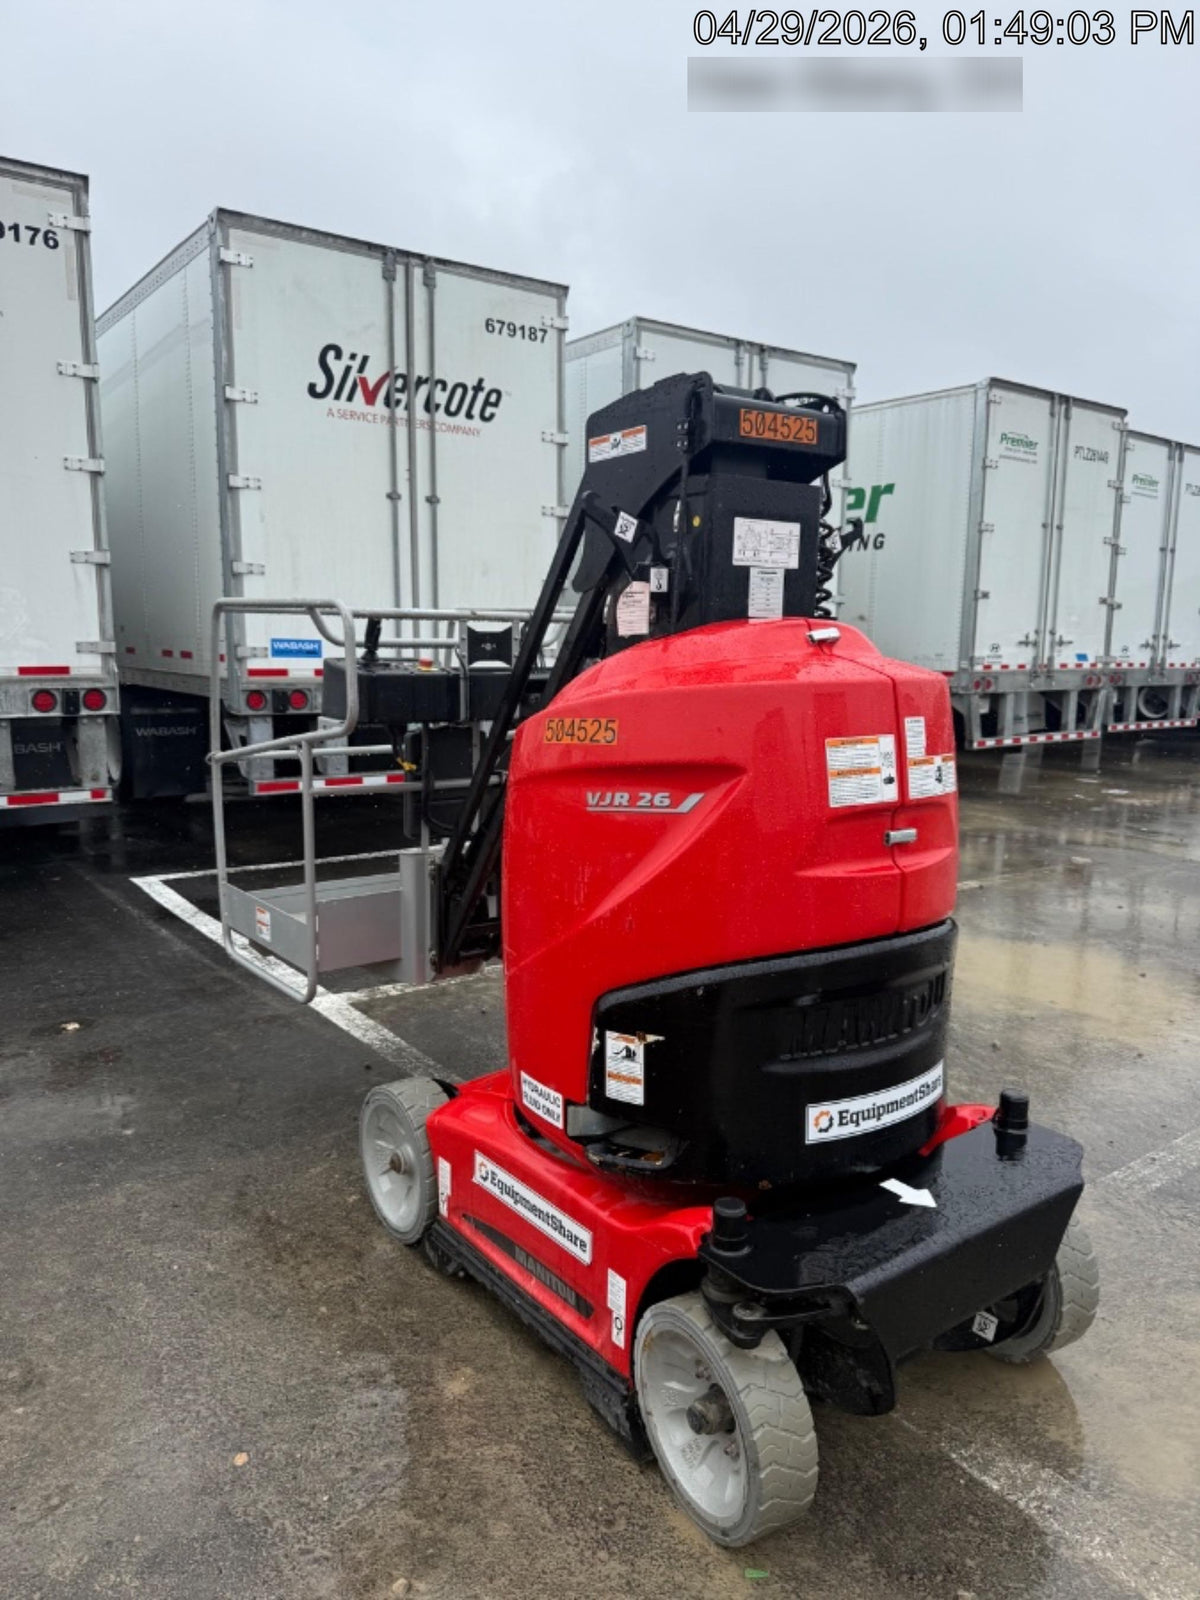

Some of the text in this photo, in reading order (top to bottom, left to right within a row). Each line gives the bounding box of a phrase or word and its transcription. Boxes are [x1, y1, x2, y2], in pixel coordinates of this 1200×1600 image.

[485, 317, 548, 343] 679187
[307, 343, 503, 423] Silvercote
[327, 407, 335, 418] A
[337, 408, 379, 424] SERVICE
[743, 410, 815, 442] 504525
[1000, 432, 1039, 450] Premier
[273, 641, 319, 651] WABASH
[136, 727, 197, 737] WABASH
[545, 719, 616, 743] 504525
[586, 792, 671, 807] VJR 26
[490, 1170, 588, 1253] EquipmentShare
